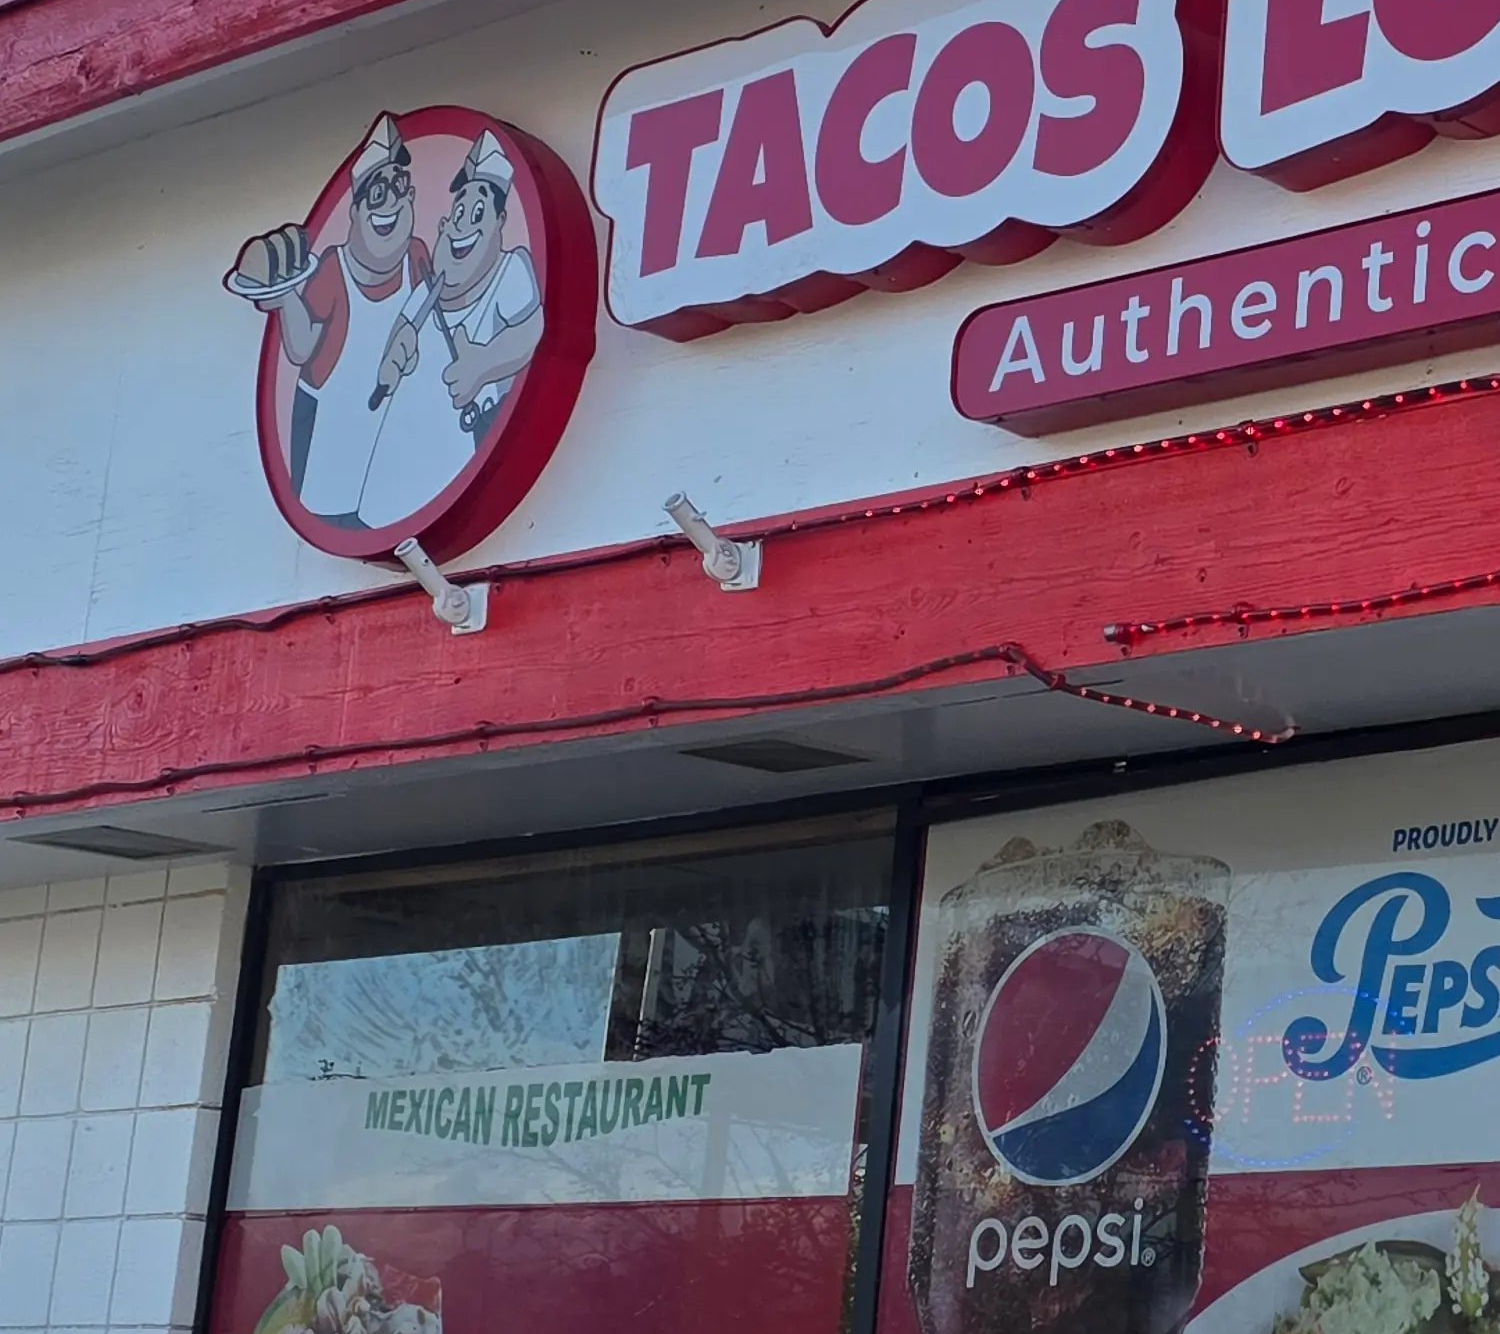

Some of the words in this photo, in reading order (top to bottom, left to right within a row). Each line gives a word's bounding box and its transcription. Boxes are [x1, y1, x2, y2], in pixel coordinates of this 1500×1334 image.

[989, 220, 1496, 393] Authentic
[1392, 818, 1499, 852] PROUDLY
[365, 1085, 497, 1146] MEXICAN
[501, 1073, 712, 1148] RESTAURANT
[1188, 1031, 1395, 1123] OPEN
[966, 1197, 1143, 1288] pepsi
